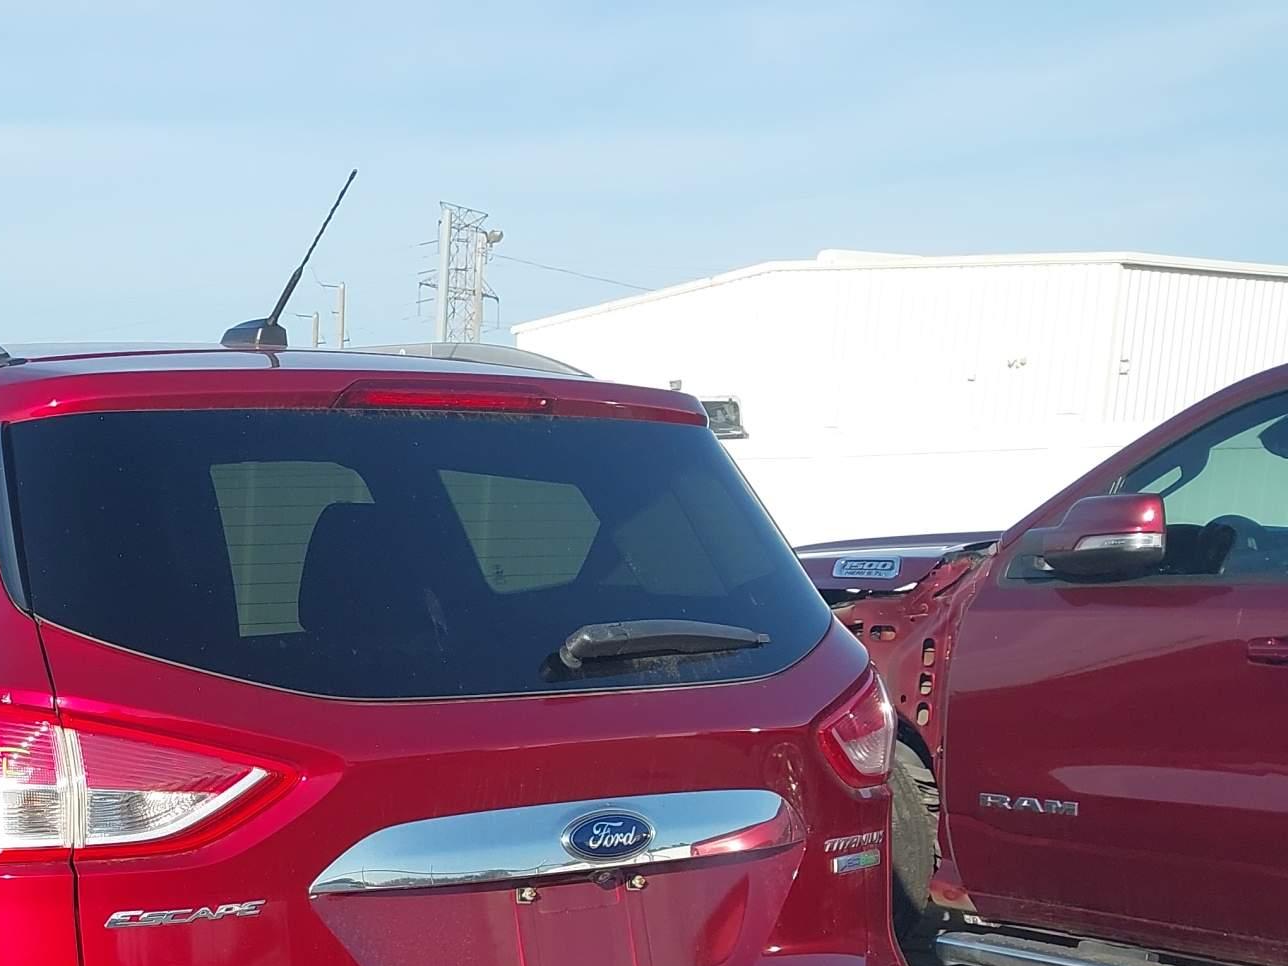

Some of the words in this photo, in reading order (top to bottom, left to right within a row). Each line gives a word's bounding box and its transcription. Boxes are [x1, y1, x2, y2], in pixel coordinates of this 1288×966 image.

[842, 560, 893, 570] 1500
[979, 792, 1079, 817] RAM
[589, 821, 638, 849] Ford
[104, 899, 267, 929] ESCAPE
